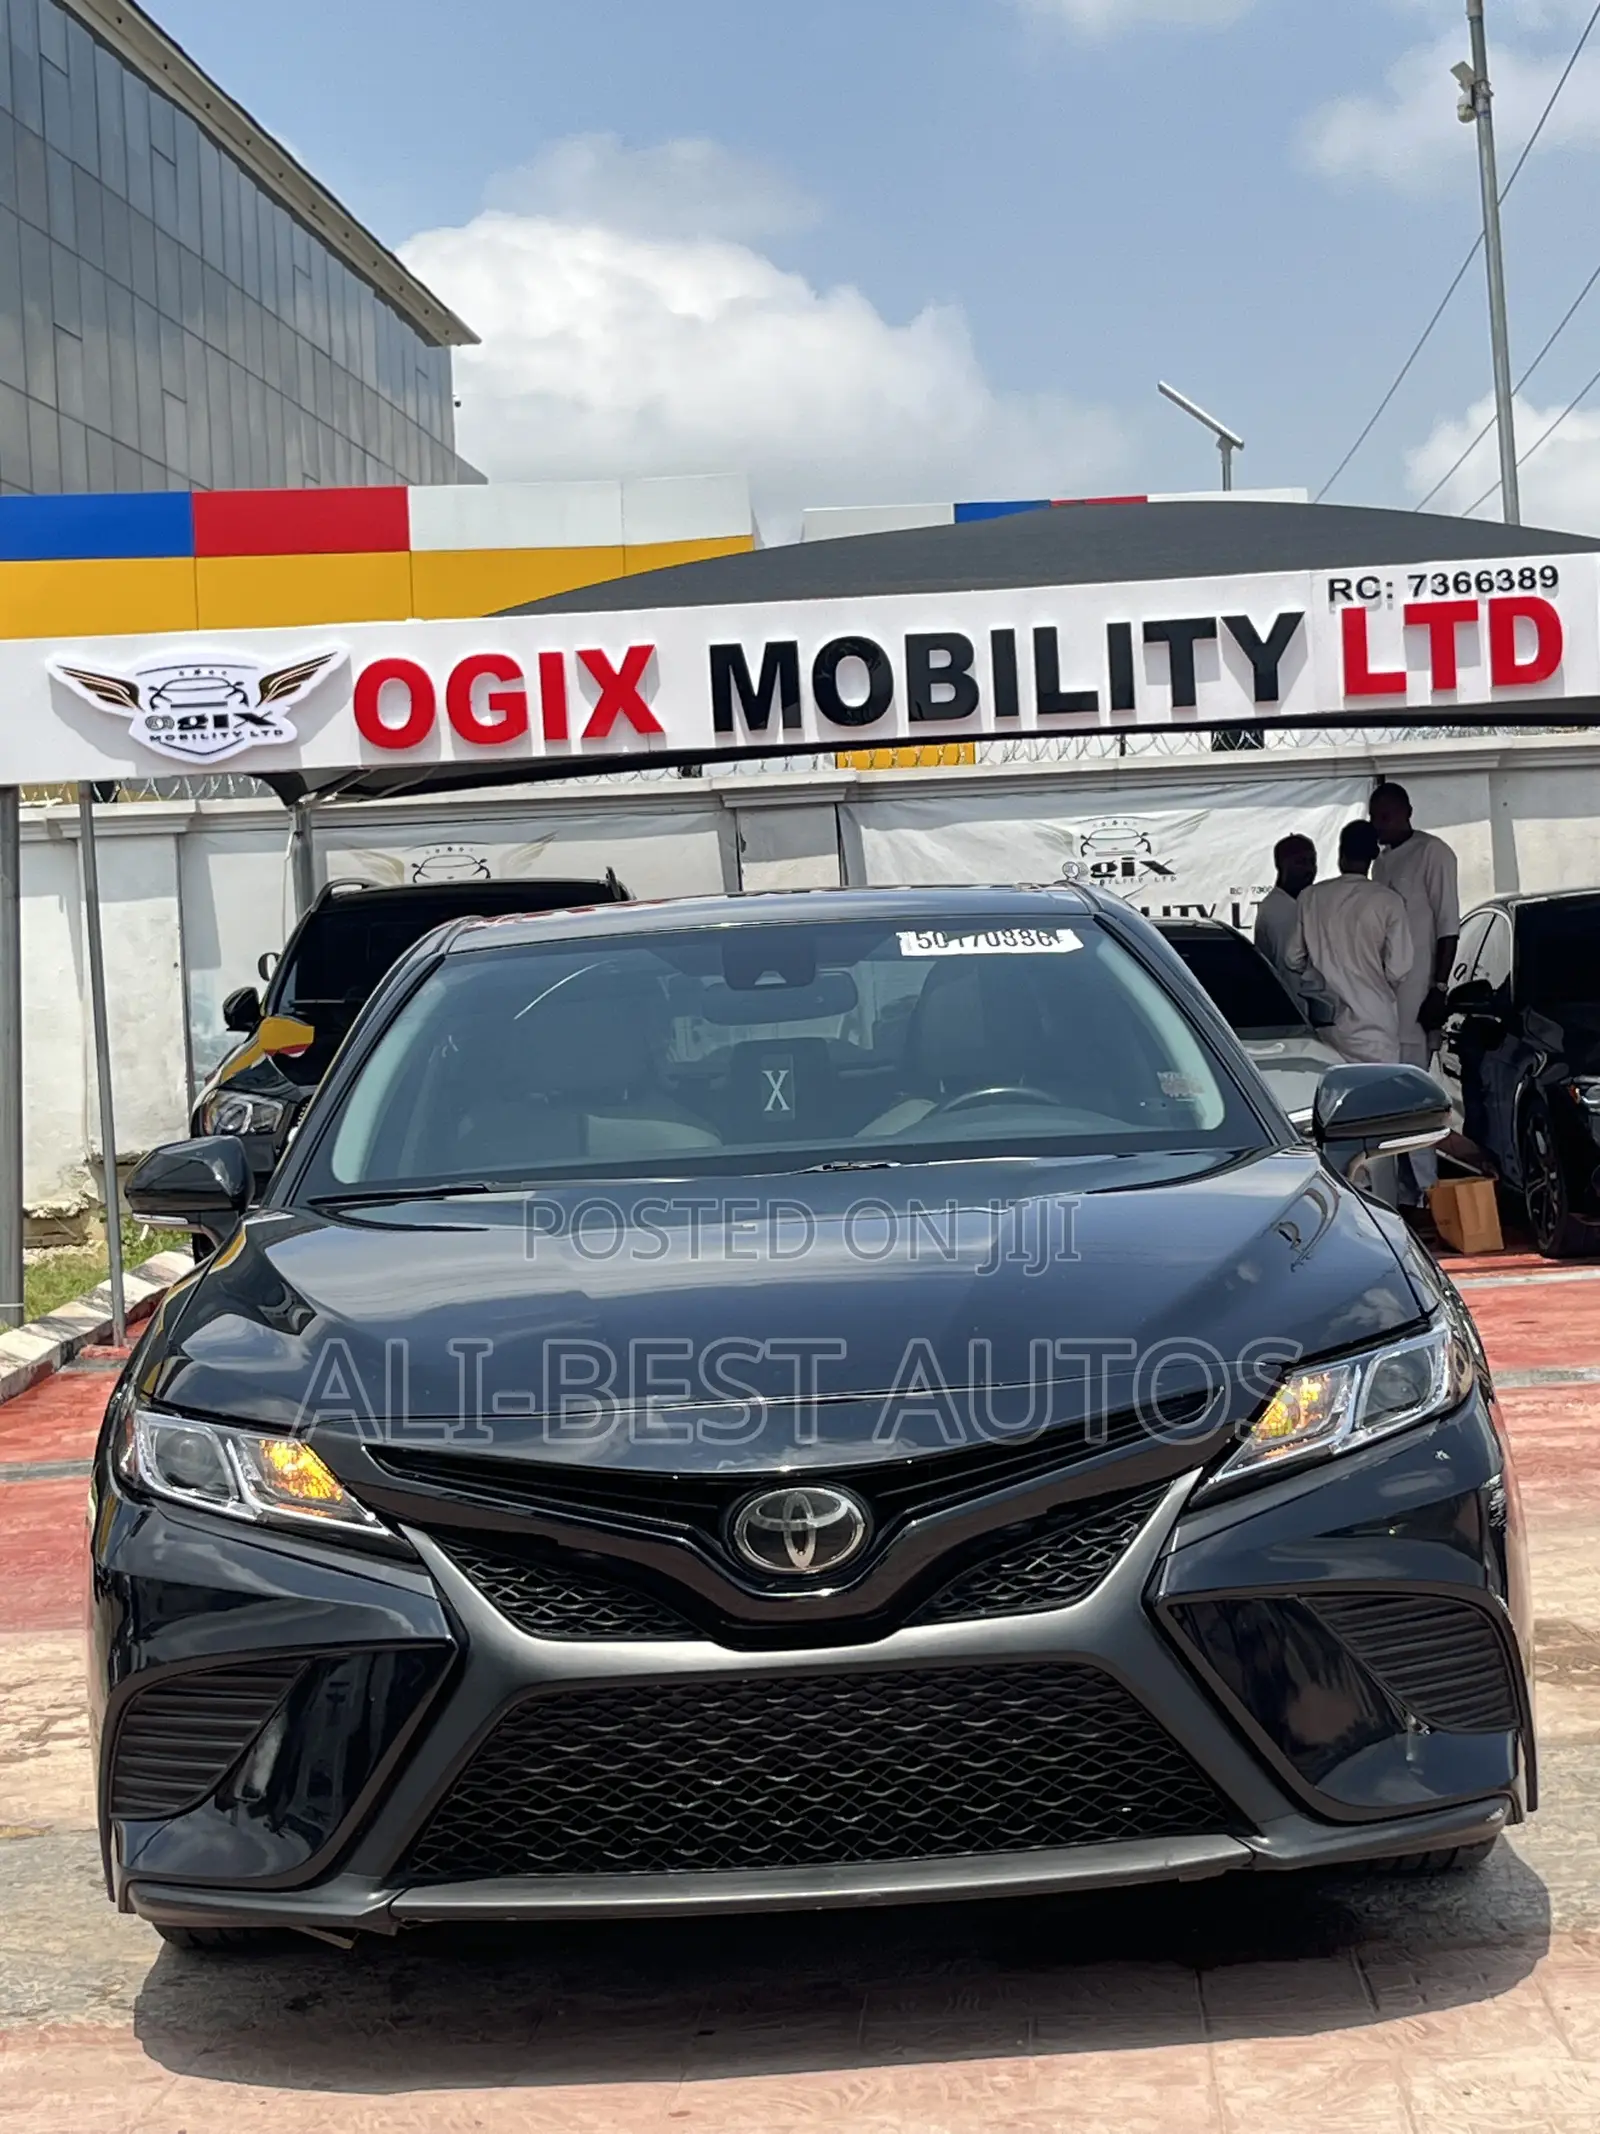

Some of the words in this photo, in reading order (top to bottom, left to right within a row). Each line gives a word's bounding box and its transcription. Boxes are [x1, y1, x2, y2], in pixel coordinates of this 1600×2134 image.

[1328, 576, 1393, 602] RC:
[1407, 565, 1559, 597] 7366389
[353, 643, 665, 748] OGIX
[709, 611, 1305, 733] MOBILITY
[1341, 596, 1563, 696] LTD
[150, 730, 242, 742] MOBILITY
[250, 728, 283, 738] LTD
[761, 1069, 791, 1112] X
